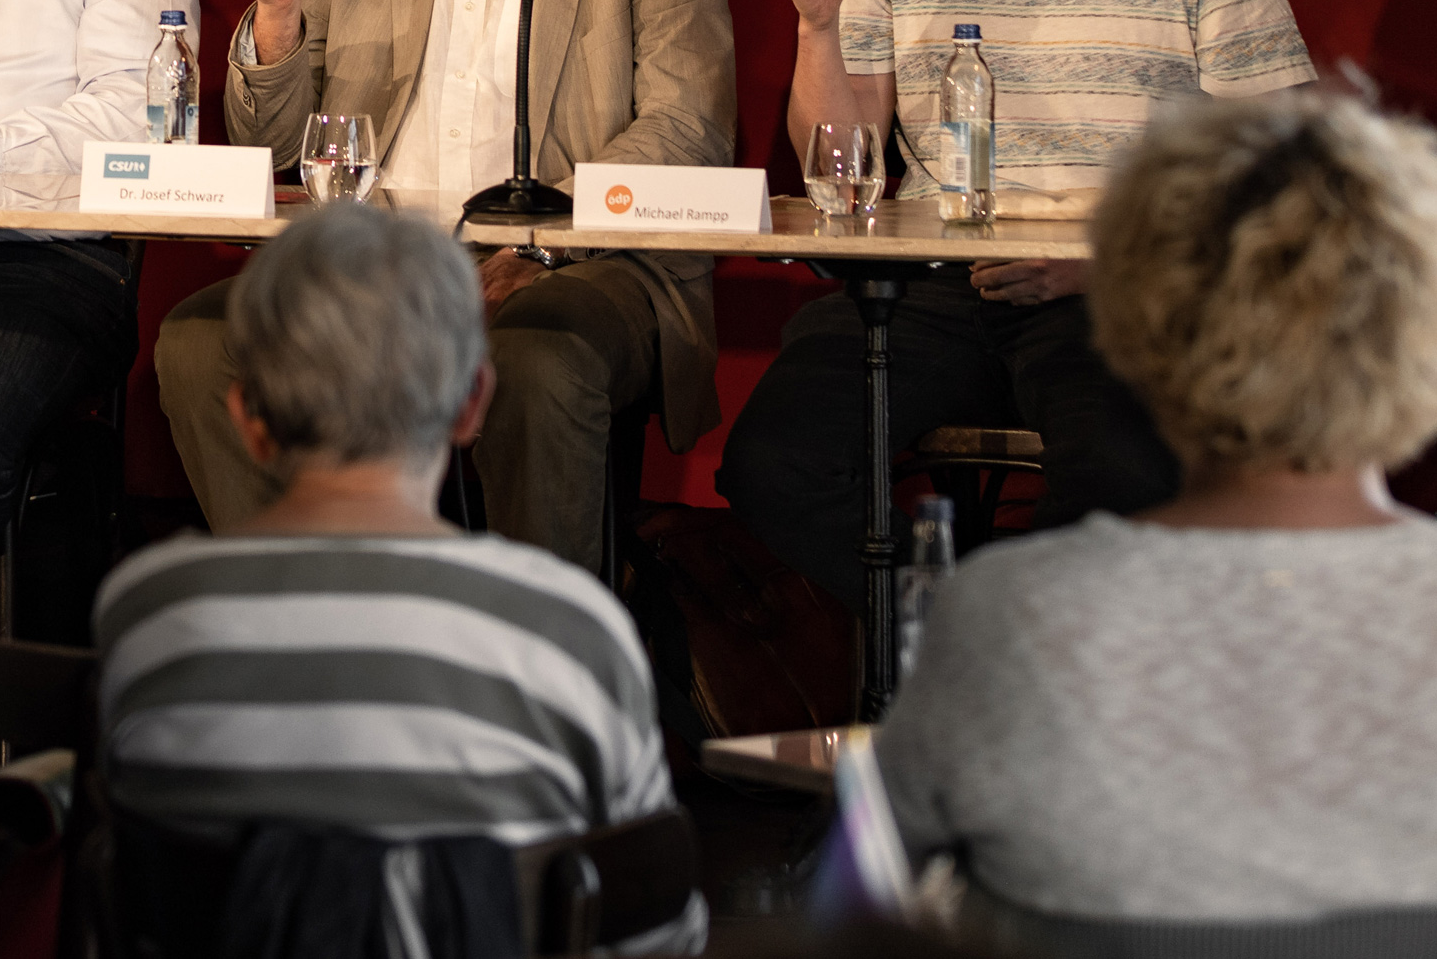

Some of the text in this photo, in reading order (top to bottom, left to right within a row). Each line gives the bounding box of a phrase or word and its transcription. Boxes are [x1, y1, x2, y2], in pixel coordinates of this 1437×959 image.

[108, 160, 133, 172] CSU
[119, 188, 225, 203] Dr. Josef Schwarz
[607, 193, 631, 206] ödp
[634, 206, 729, 223] Michael Rampp
